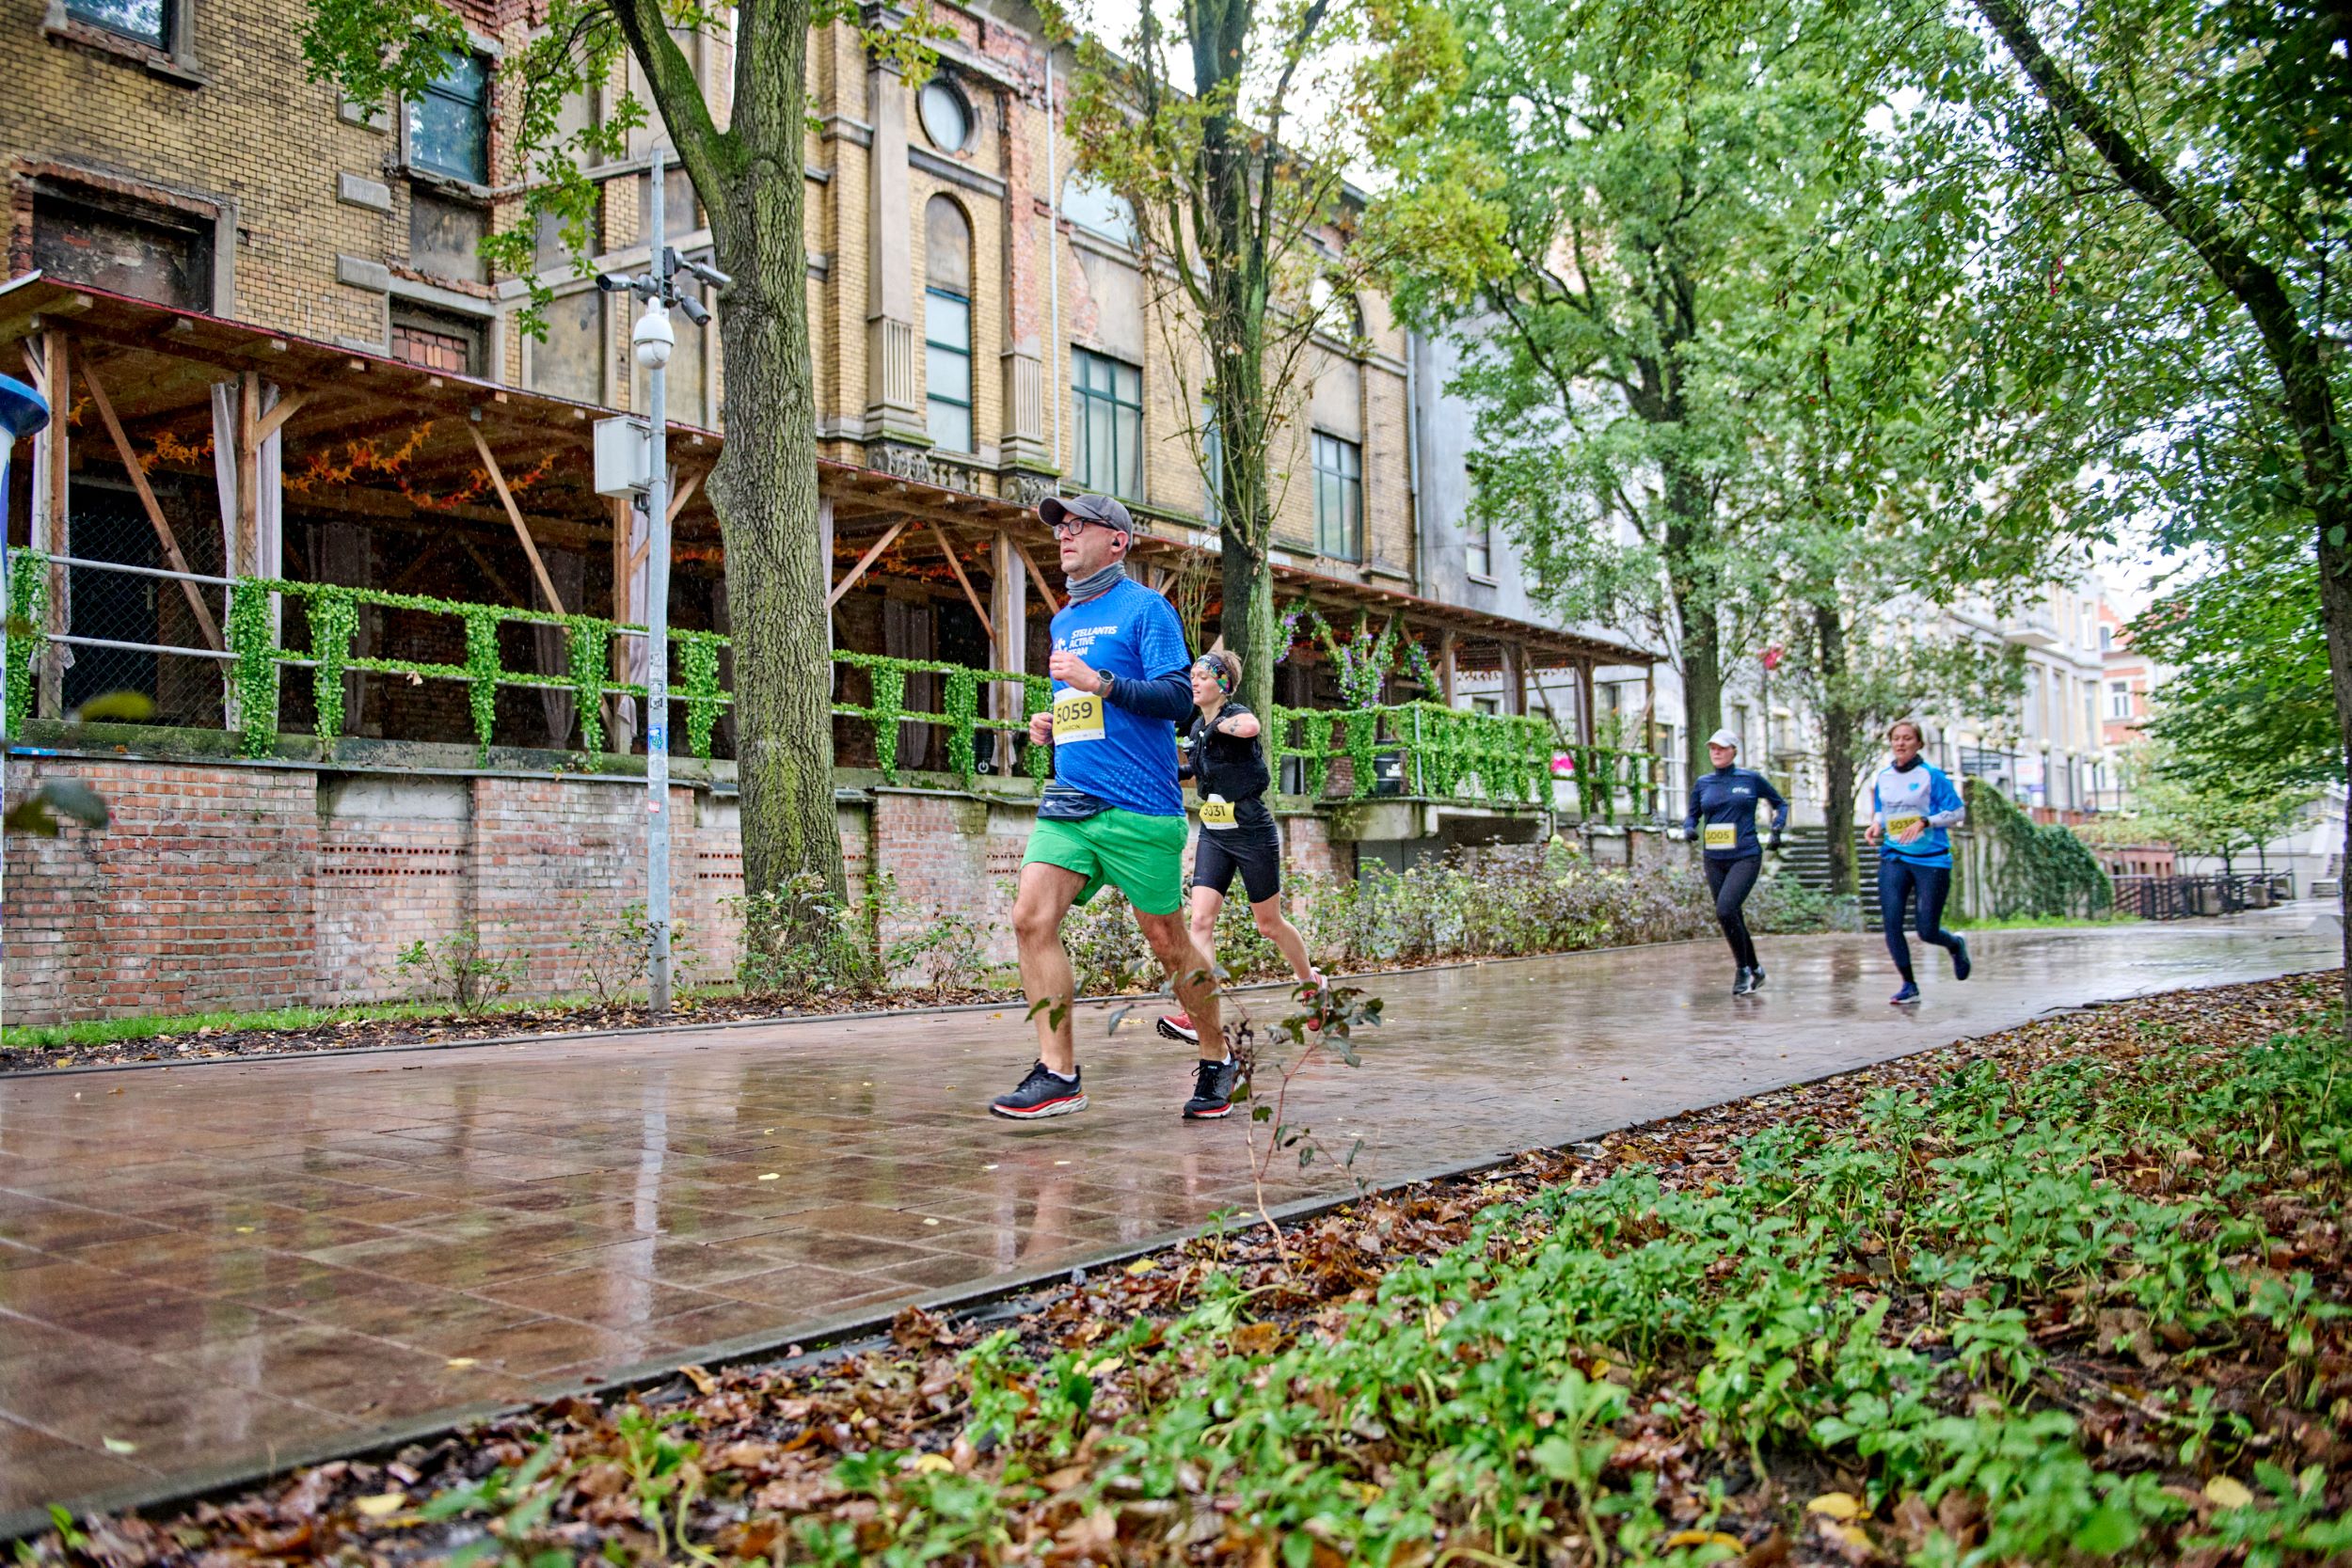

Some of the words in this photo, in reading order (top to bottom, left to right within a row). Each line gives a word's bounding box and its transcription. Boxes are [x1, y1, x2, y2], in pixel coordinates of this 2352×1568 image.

[1071, 626, 1118, 639] STELLANTIS
[1069, 636, 1096, 649] ACTIVE
[1057, 701, 1092, 725] 5059
